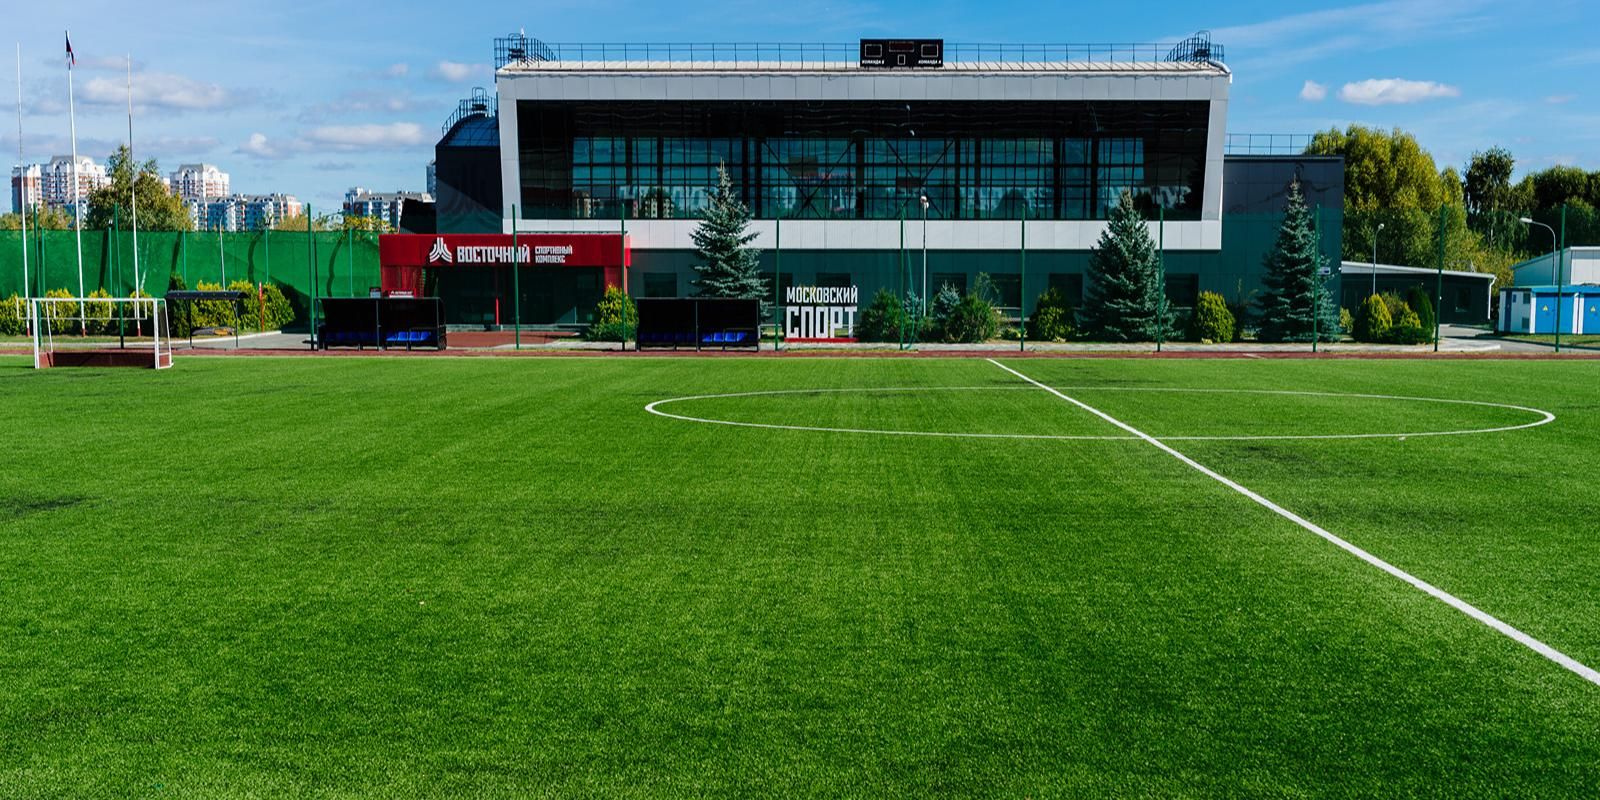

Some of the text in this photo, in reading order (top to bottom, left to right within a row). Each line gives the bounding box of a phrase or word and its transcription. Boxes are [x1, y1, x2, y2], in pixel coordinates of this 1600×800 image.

[457, 244, 530, 263] ВОСТОЧНЫЙ
[535, 245, 573, 254] СПОРТИВНЫЙ
[535, 255, 566, 263] КОМПЛЕКС
[786, 285, 858, 303] МОСКОВСКИЙ
[786, 306, 858, 338] СПОРТ
